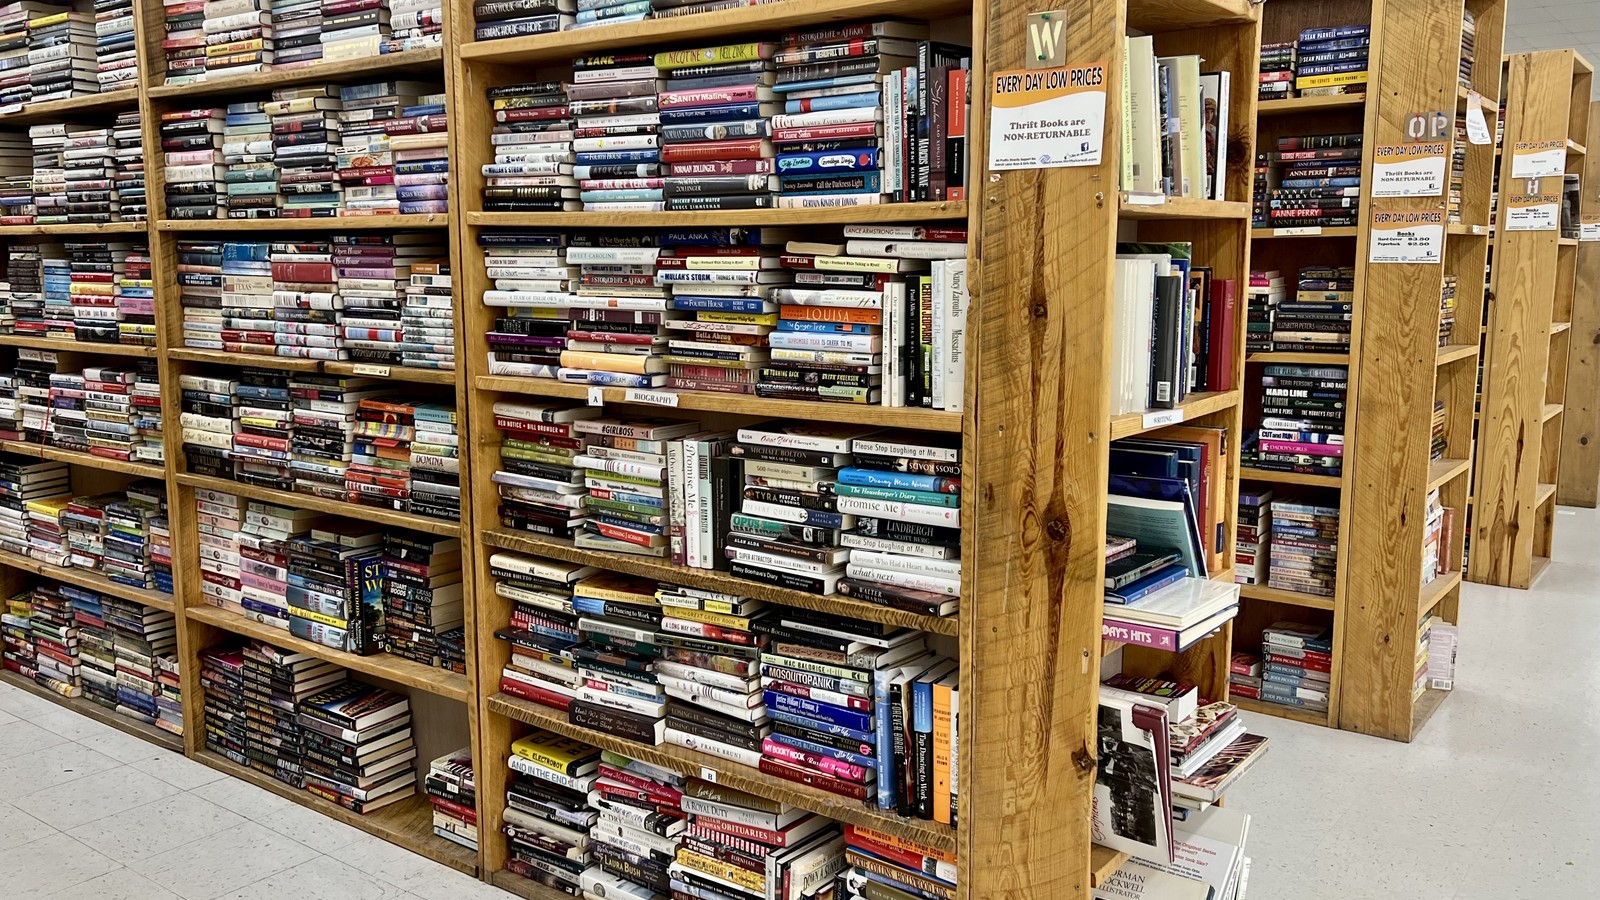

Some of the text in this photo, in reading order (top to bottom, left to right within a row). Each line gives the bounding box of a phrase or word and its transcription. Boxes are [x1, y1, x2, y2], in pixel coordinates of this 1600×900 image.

[1030, 21, 1063, 60] W
[587, 56, 614, 65] ZANE
[996, 67, 1102, 94] EVERY DAY LOW PRICES
[1010, 121, 1038, 130] Thrift
[1040, 119, 1068, 128] Books
[1004, 129, 1091, 141] NON-RETURNABLE
[1377, 145, 1444, 156] EVERY DAY LOW PRICES
[1527, 180, 1538, 194] H
[1275, 209, 1319, 217] ANNE PERRY
[1375, 213, 1441, 222] EVERY DAY LOW PRICES
[952, 271, 964, 317] Nancy Zaroulis
[806, 309, 849, 321] LOUISA
[686, 380, 696, 388] Say
[634, 393, 673, 404] BIOGRAPHY
[527, 423, 537, 431] BILL
[538, 425, 558, 433] BROWDER
[601, 425, 634, 437] #GIRLBOSS
[750, 447, 807, 459] MICHAEL BOLTON
[416, 455, 443, 466] DOMINA
[909, 463, 960, 474] CROSS ROADS
[686, 445, 696, 508] Promise Me
[755, 491, 778, 501] TYRA
[862, 488, 898, 497] Housekeeper's
[899, 492, 916, 501] Diary
[841, 497, 898, 513] Promise Me
[733, 516, 760, 529] OPUS
[887, 521, 934, 537] LINDBERGH
[751, 554, 772, 563] ATTRACTOR
[854, 555, 874, 564] Anyone
[875, 558, 888, 566] Who
[605, 605, 613, 613] Tap
[614, 607, 632, 616] Dancing
[637, 611, 650, 619] Work
[1130, 629, 1152, 644] HITS
[769, 667, 834, 689] MOSQUITOPANIK!
[671, 707, 692, 718] LOSING
[775, 713, 818, 727] MARCUS BUTLER
[700, 743, 741, 759] FRANK BRUNI
[780, 737, 823, 753] MARCUS BUTLER
[532, 752, 563, 770] ELECTROBOY
[511, 761, 567, 785] AND IN THE END
[692, 801, 710, 814] ROYAL
[711, 806, 728, 818] DUTY
[722, 823, 768, 839] OBITUARIES
[856, 826, 891, 842] MARK BOWDEN
[1182, 842, 1202, 851] Original
[604, 855, 641, 877] LAURA BUSH
